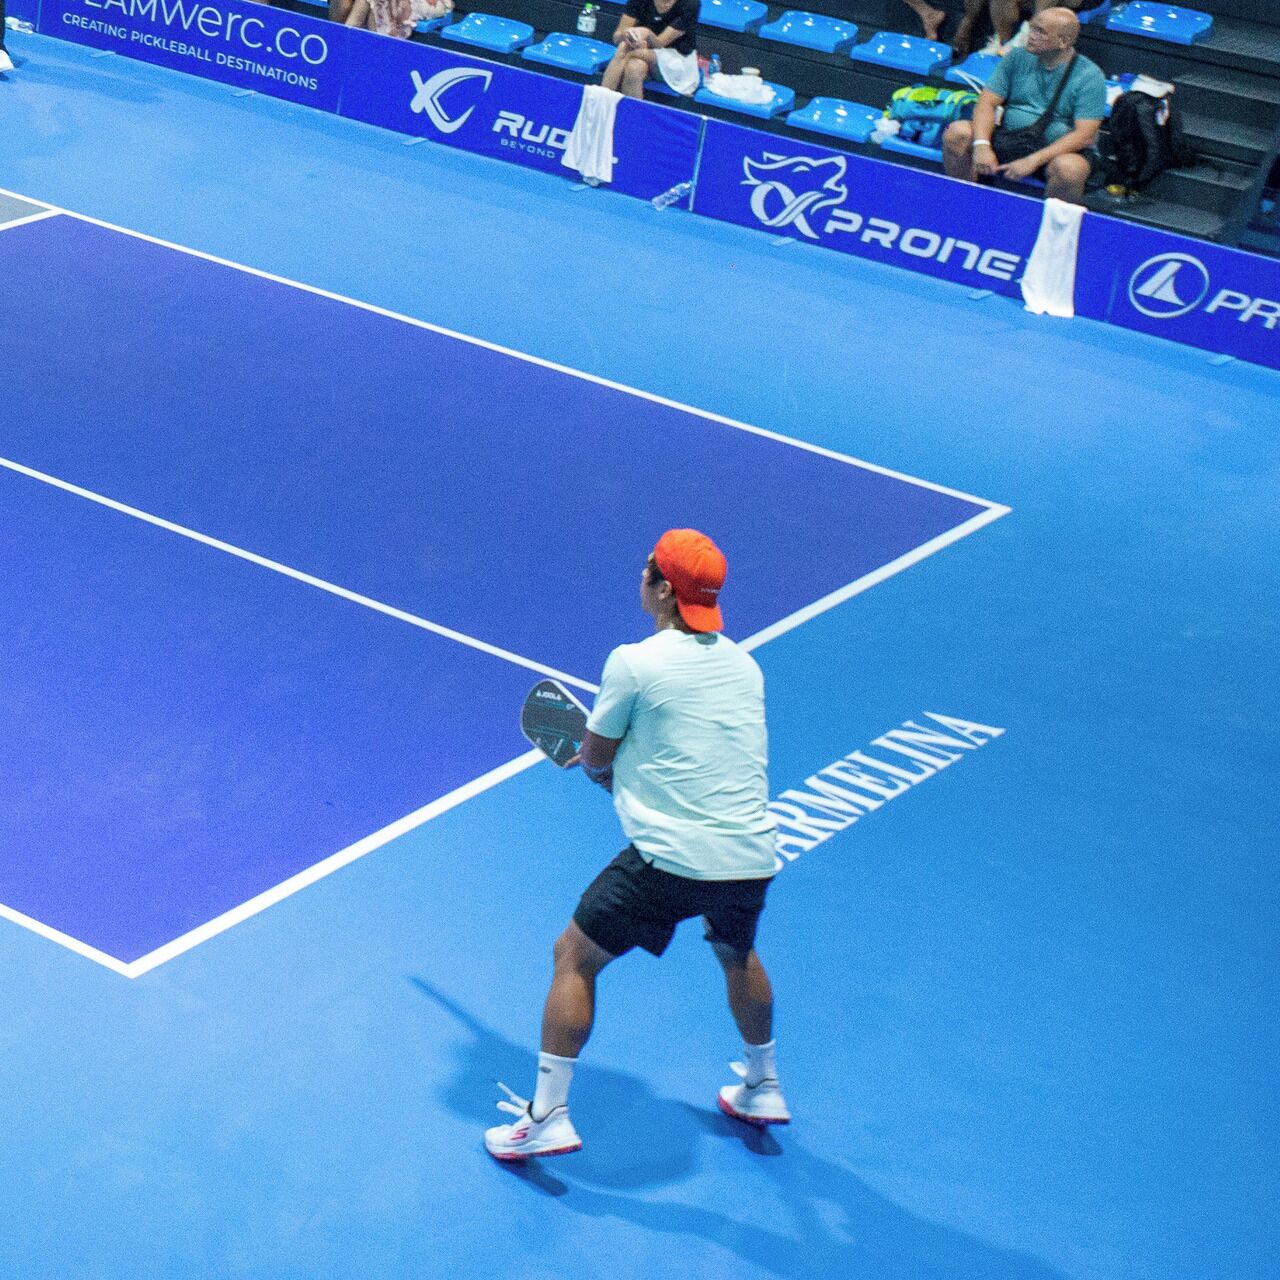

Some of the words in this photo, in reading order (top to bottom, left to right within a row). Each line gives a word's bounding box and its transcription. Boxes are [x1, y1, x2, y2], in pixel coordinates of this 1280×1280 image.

[62, 12, 127, 40] CREATING
[130, 31, 212, 62] PICKLEBALL
[215, 53, 318, 90] DESTINATIONS
[493, 110, 572, 150] RUD
[500, 138, 556, 160] BEYOND
[824, 208, 1022, 281] PRONE
[766, 710, 1007, 872] ARMELINA
